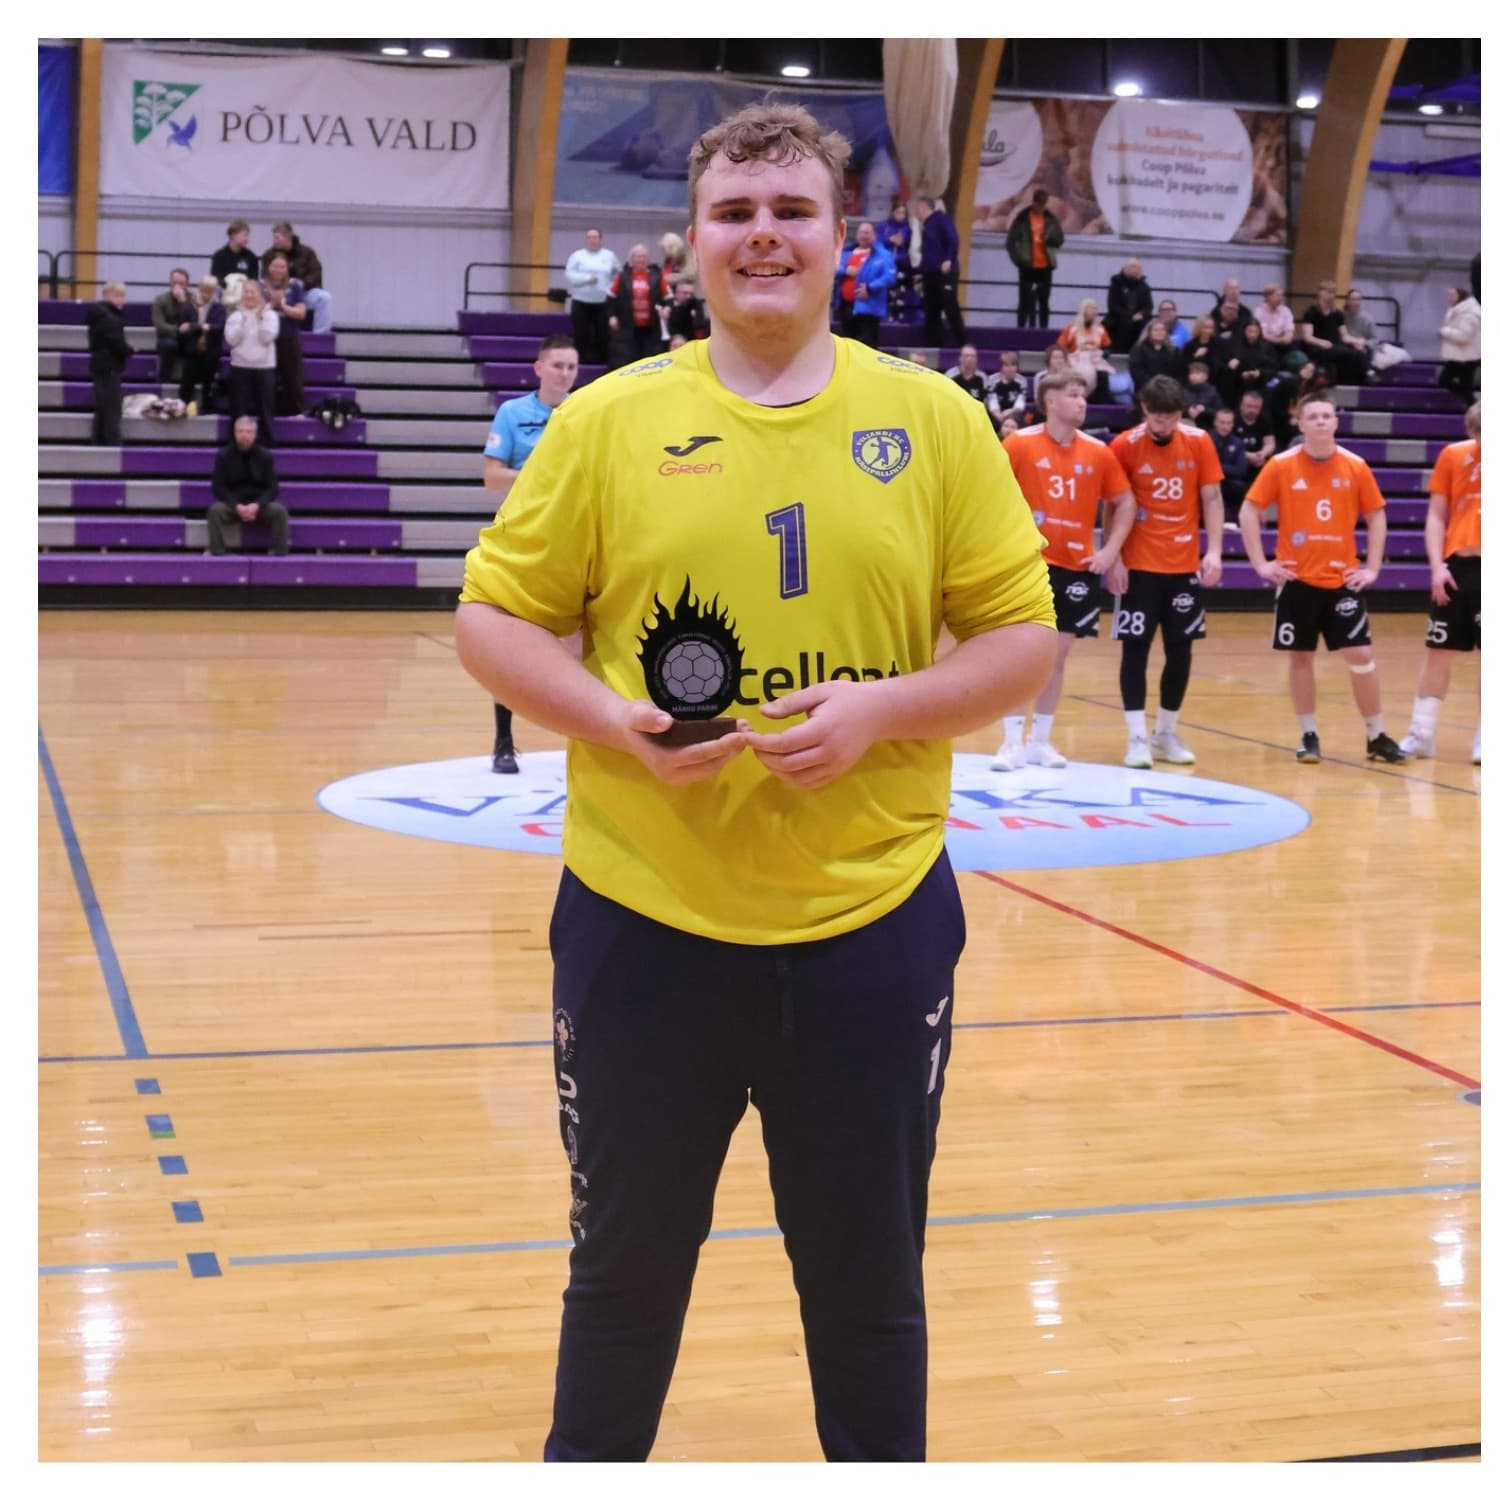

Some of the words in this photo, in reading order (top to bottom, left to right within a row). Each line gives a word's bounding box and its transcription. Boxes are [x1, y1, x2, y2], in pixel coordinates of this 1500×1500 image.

[220, 105, 354, 147] PÕLVA
[366, 117, 477, 151] VALD
[658, 460, 723, 476] Gren
[1048, 475, 1076, 500] 31
[1152, 477, 1183, 500] 28
[1316, 499, 1332, 521] 6
[765, 502, 808, 600] 1
[1117, 610, 1145, 635] 28
[1278, 622, 1295, 646] 6
